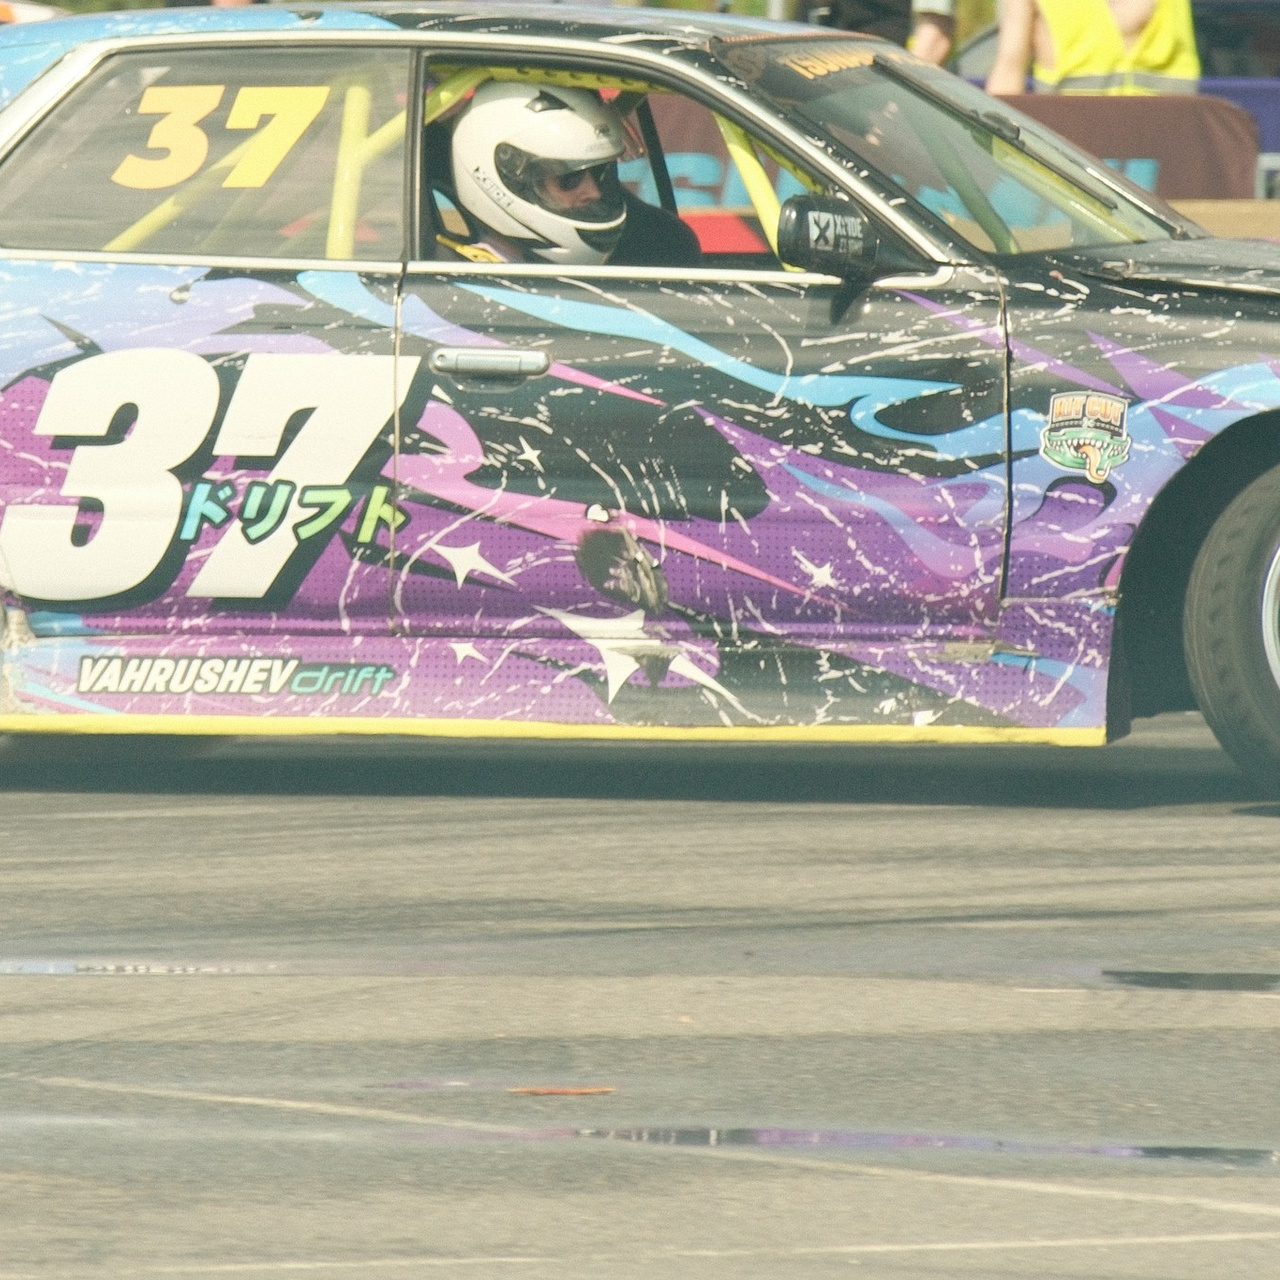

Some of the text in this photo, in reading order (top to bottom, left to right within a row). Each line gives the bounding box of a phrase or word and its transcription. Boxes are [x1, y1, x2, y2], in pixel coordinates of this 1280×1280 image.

[110, 85, 331, 189] 37
[1052, 396, 1125, 426] KIT CUT
[180, 482, 407, 543] ドリフト
